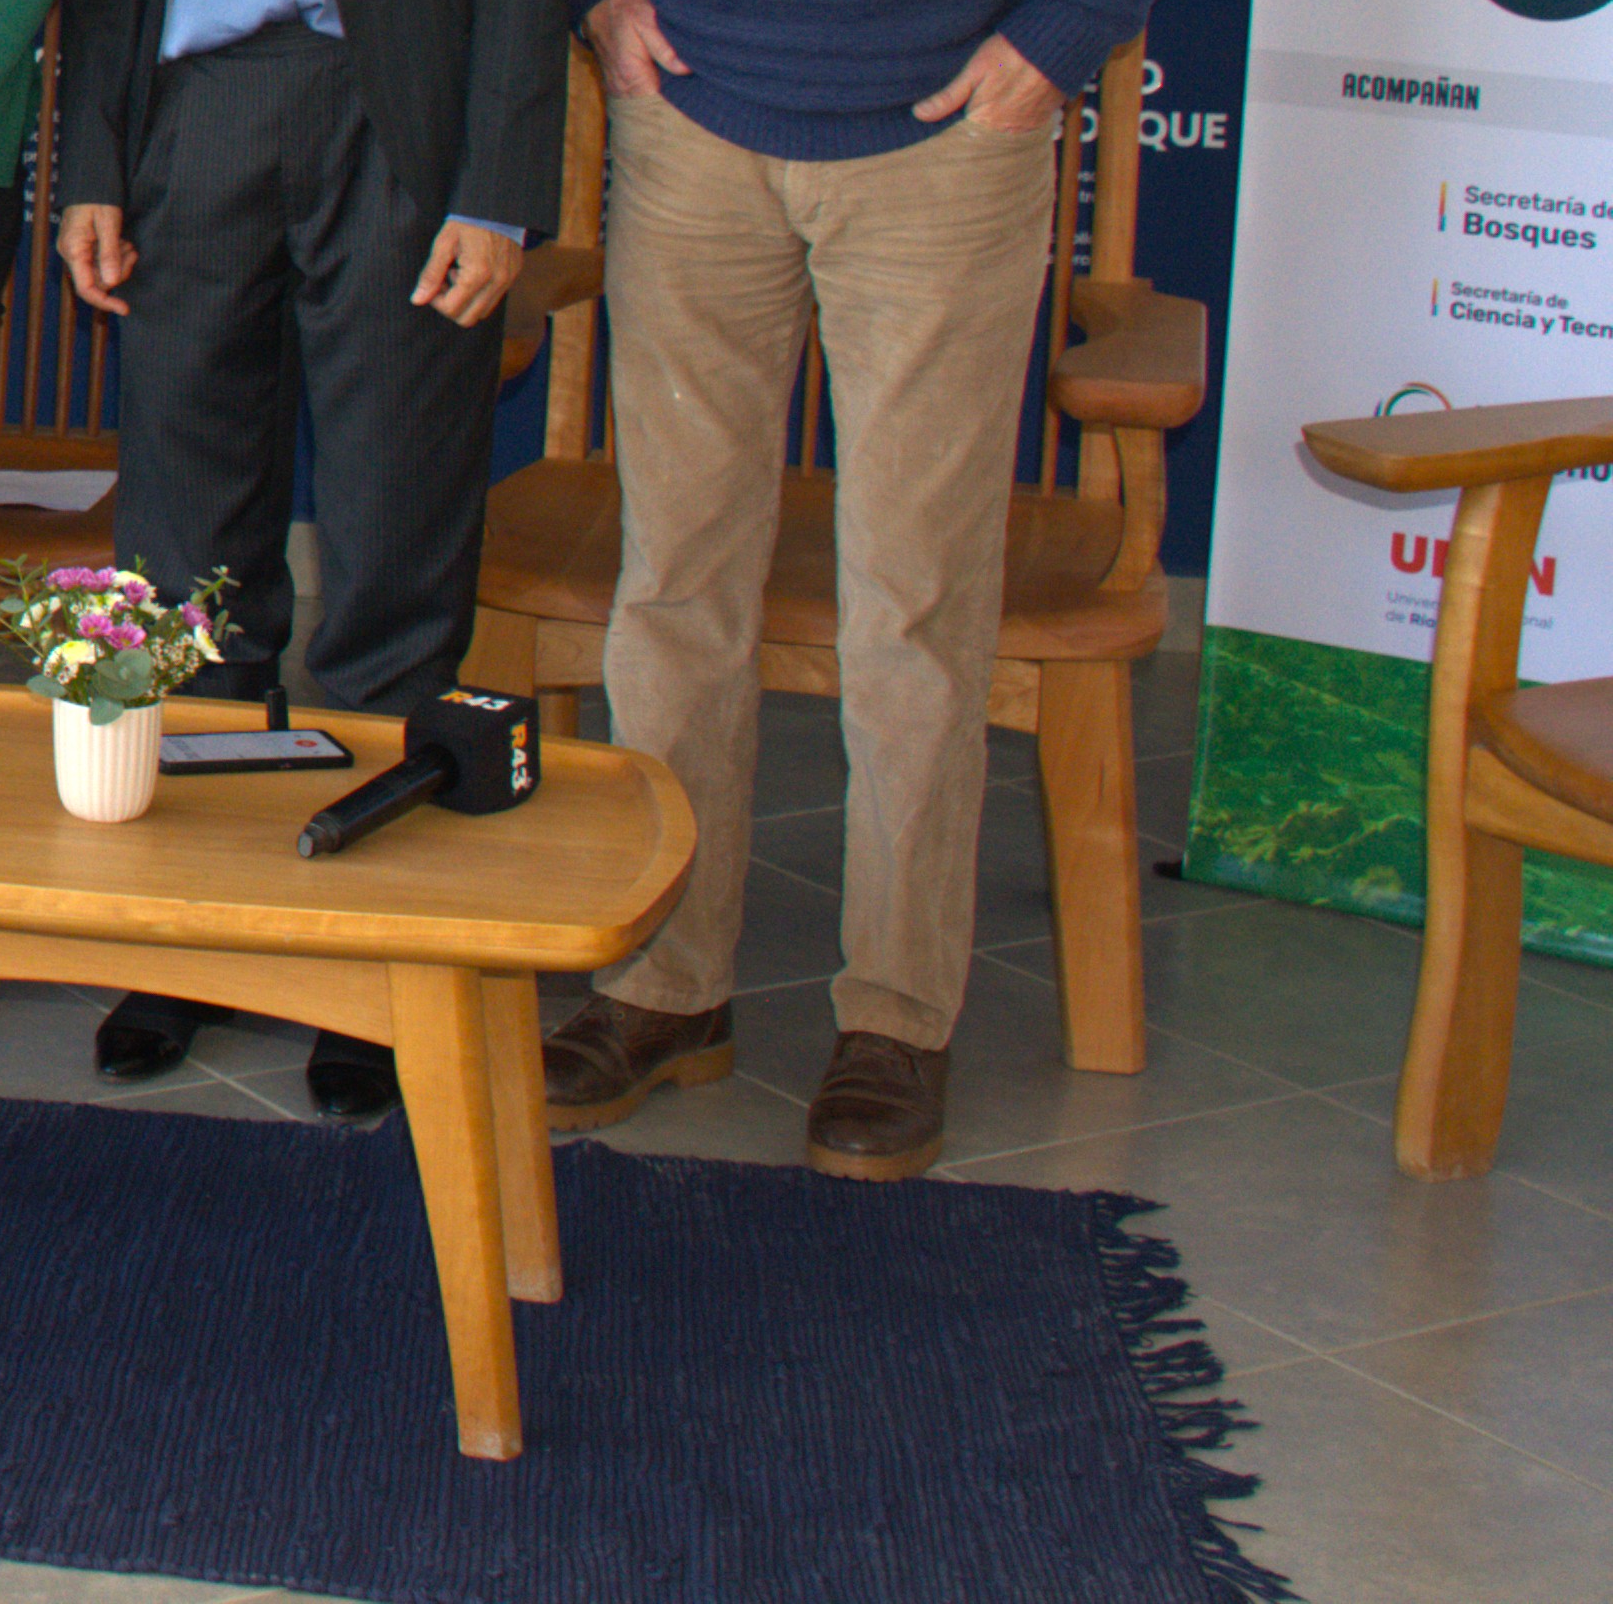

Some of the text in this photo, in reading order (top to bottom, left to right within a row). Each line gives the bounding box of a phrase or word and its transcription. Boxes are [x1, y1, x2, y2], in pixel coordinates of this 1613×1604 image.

[1342, 73, 1480, 109] ACOMPAÑAN
[1463, 185, 1587, 218] Secretaría
[1463, 210, 1598, 249] Bosques
[1450, 281, 1569, 309] Secretaría de
[1449, 300, 1537, 328] Ciencia
[1540, 316, 1556, 336] y
